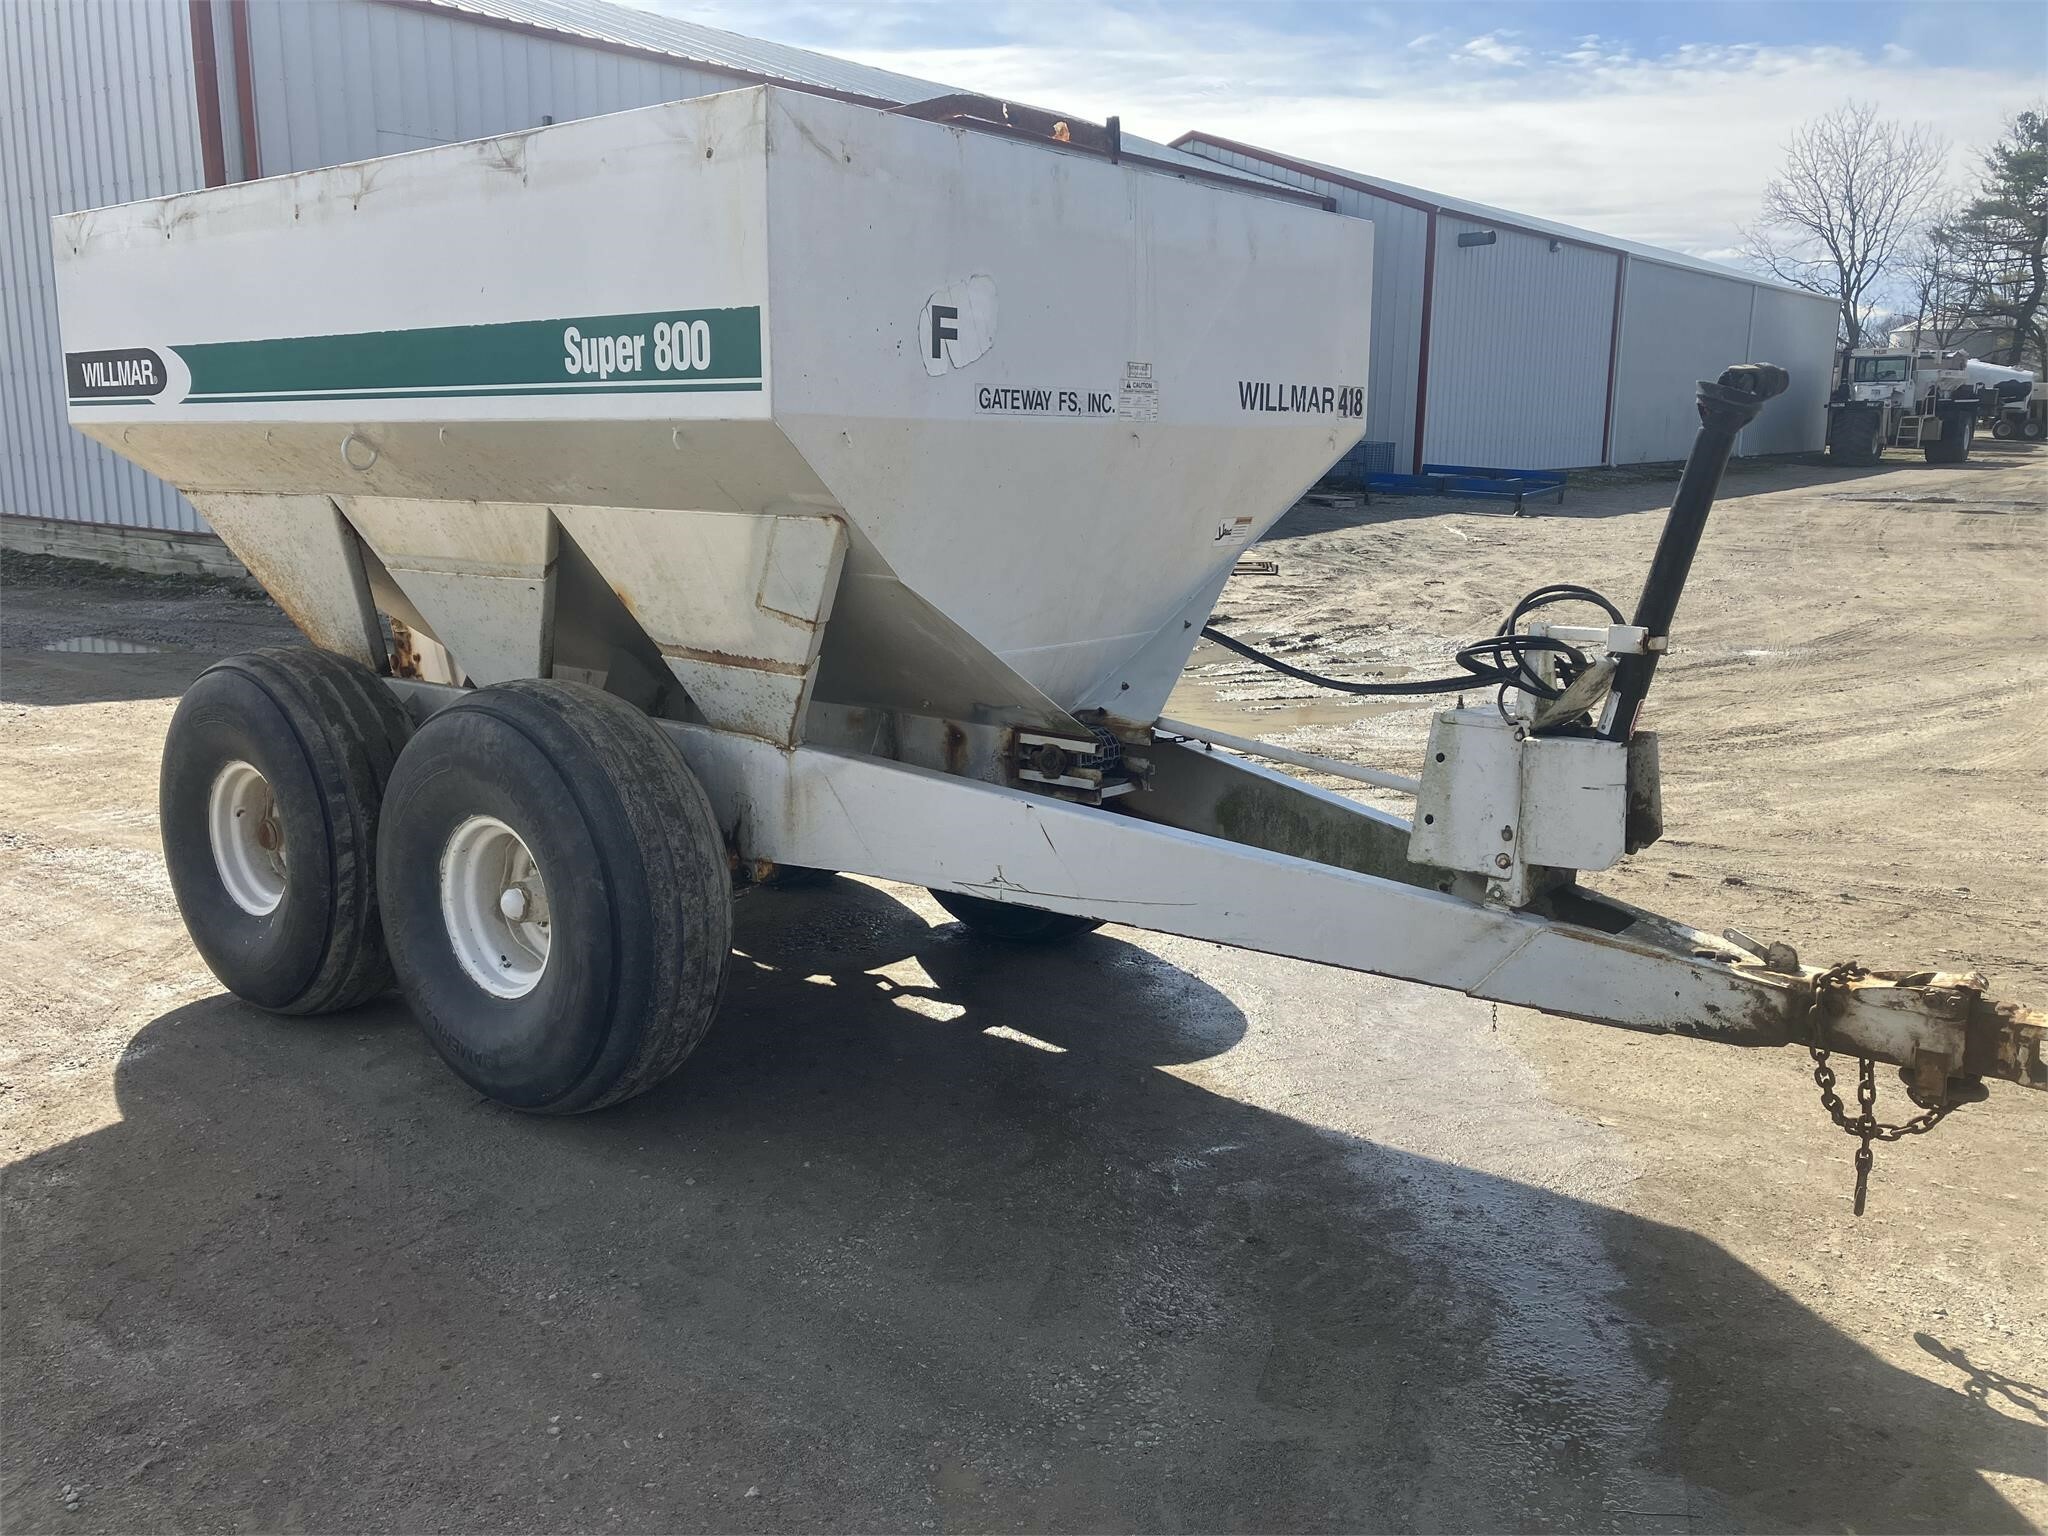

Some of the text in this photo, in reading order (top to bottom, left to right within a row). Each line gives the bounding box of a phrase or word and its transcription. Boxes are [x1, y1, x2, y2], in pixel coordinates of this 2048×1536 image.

[931, 305, 958, 359] F
[563, 320, 711, 380] Super 800
[81, 359, 155, 387] WILLMAR
[1132, 381, 1153, 389] CAUTION
[978, 387, 1052, 411] GATEWAY
[1058, 391, 1082, 416] FS,
[1087, 392, 1116, 414] INC.
[1238, 380, 1363, 417] WILLMAR 418
